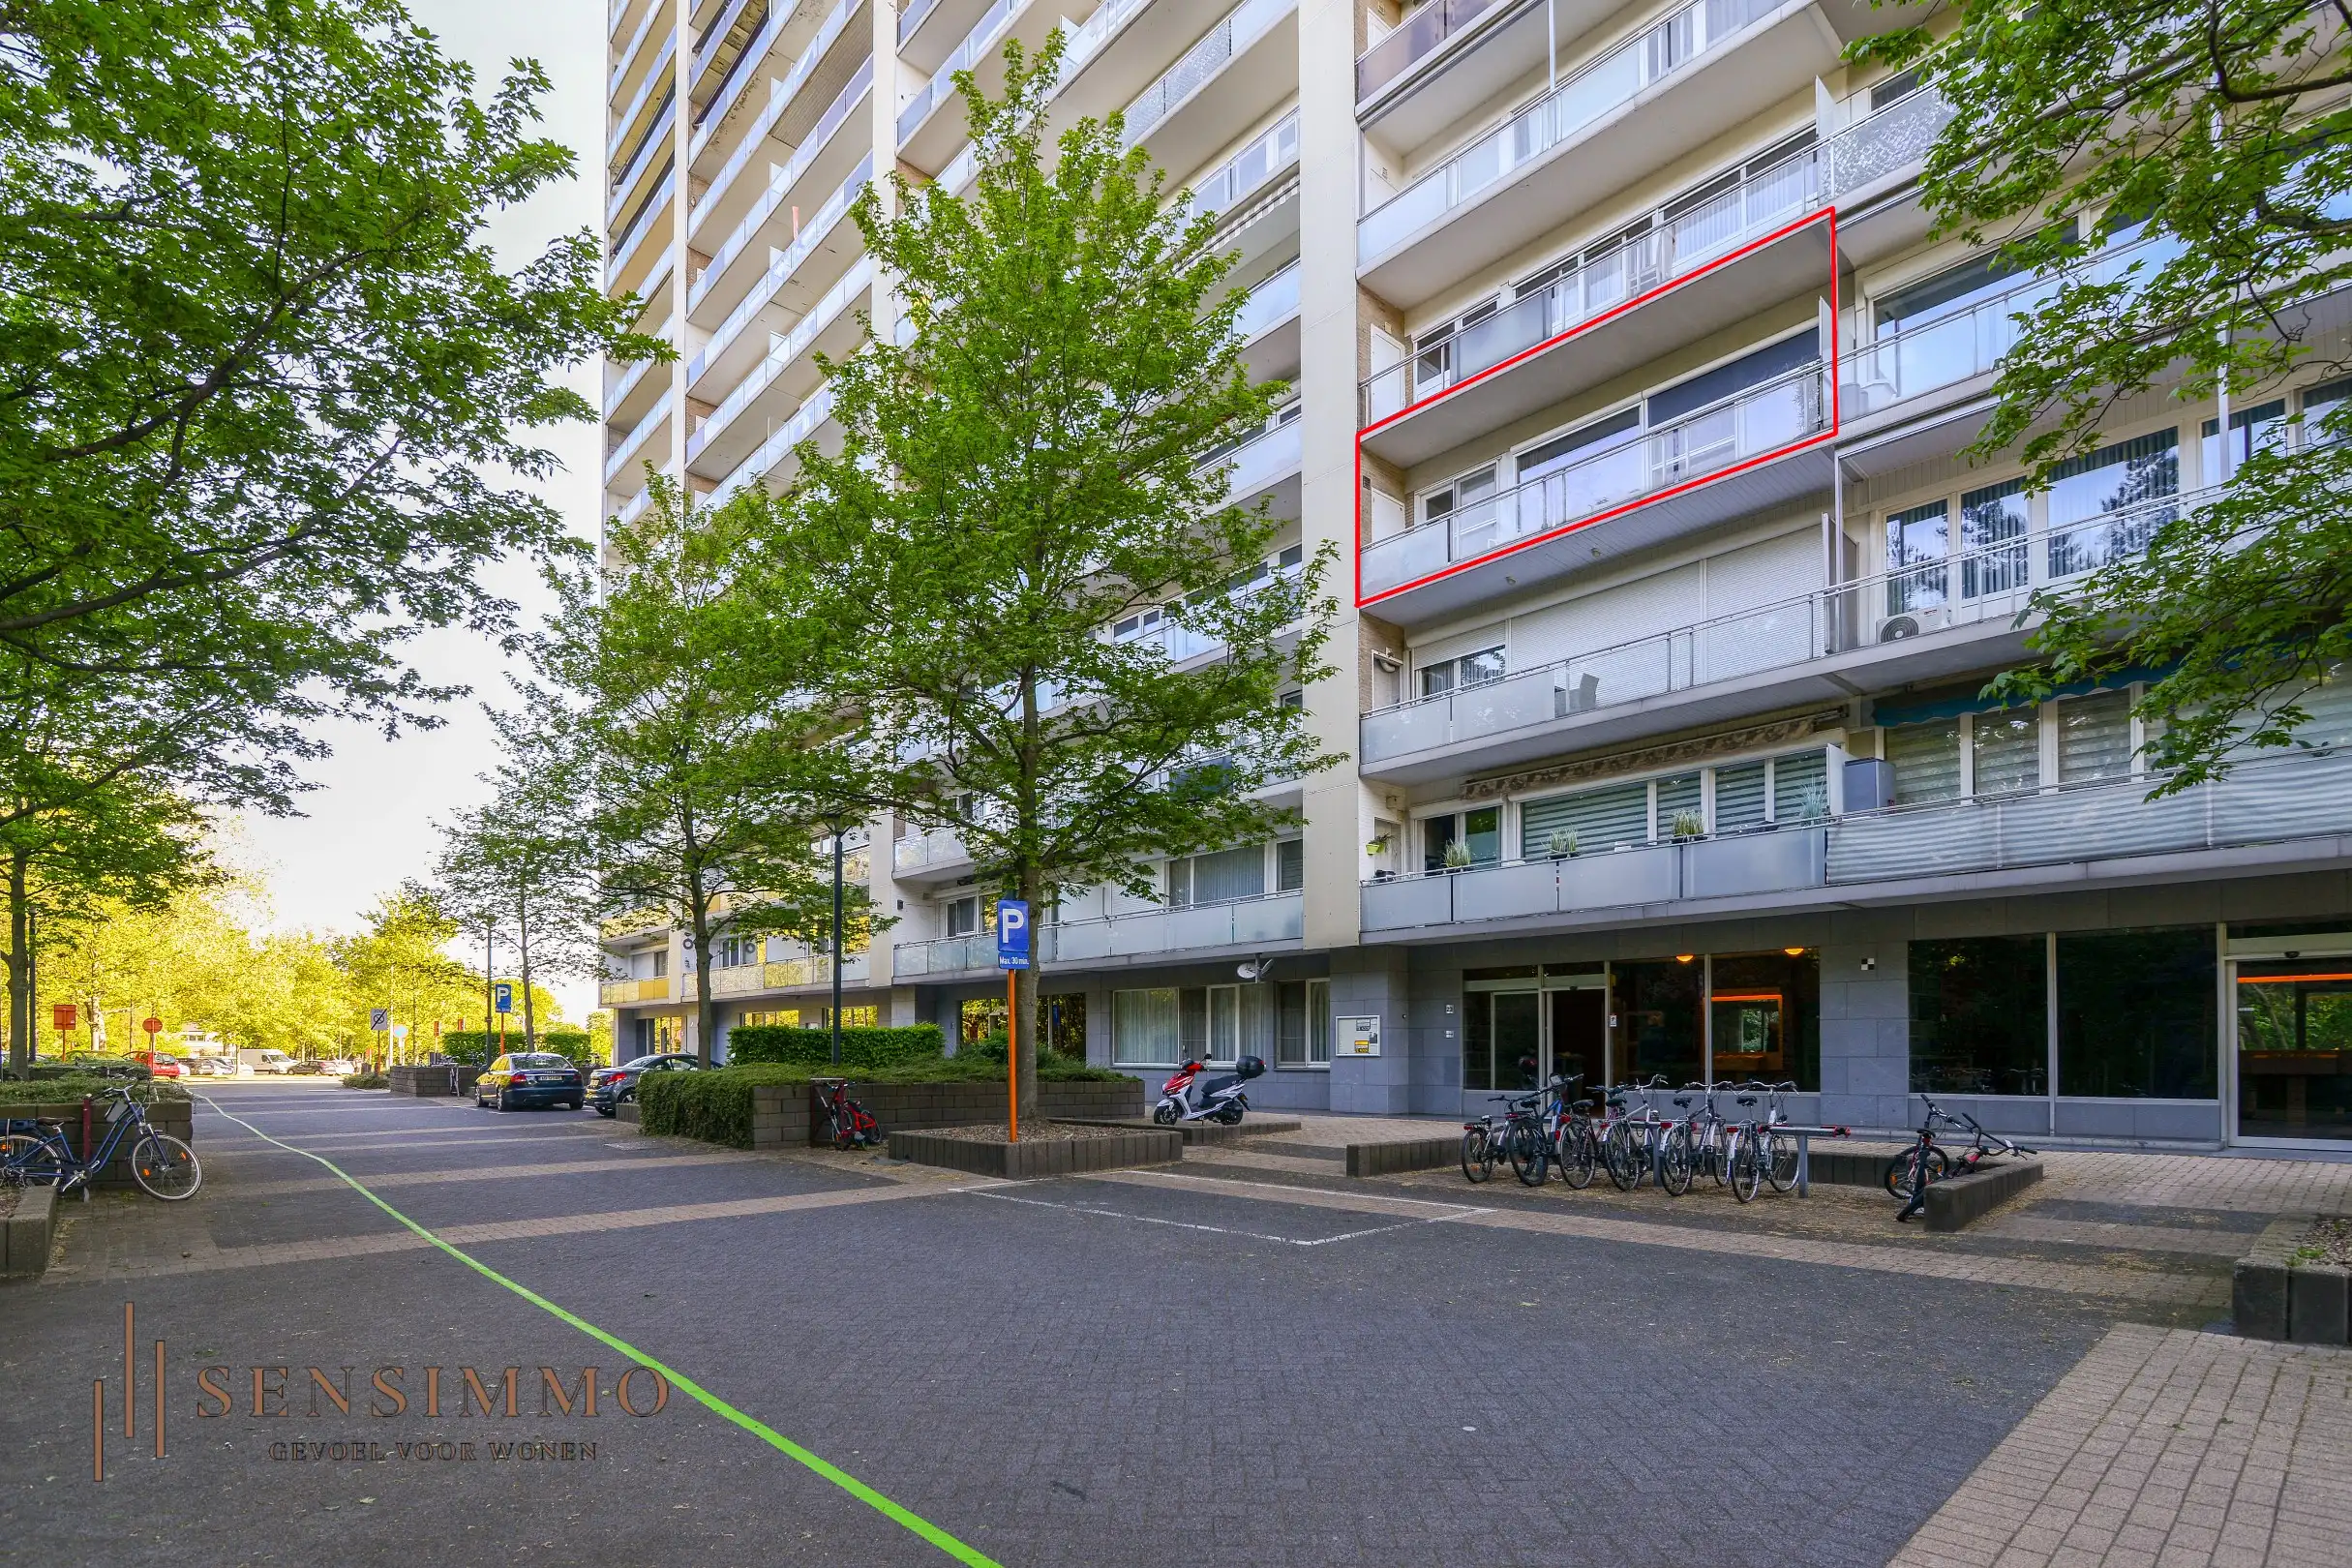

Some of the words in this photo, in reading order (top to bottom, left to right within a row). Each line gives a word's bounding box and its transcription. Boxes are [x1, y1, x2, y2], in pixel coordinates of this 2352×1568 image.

[1002, 908, 1024, 944] P
[1010, 956, 1018, 965] 30
[497, 987, 509, 1003] P
